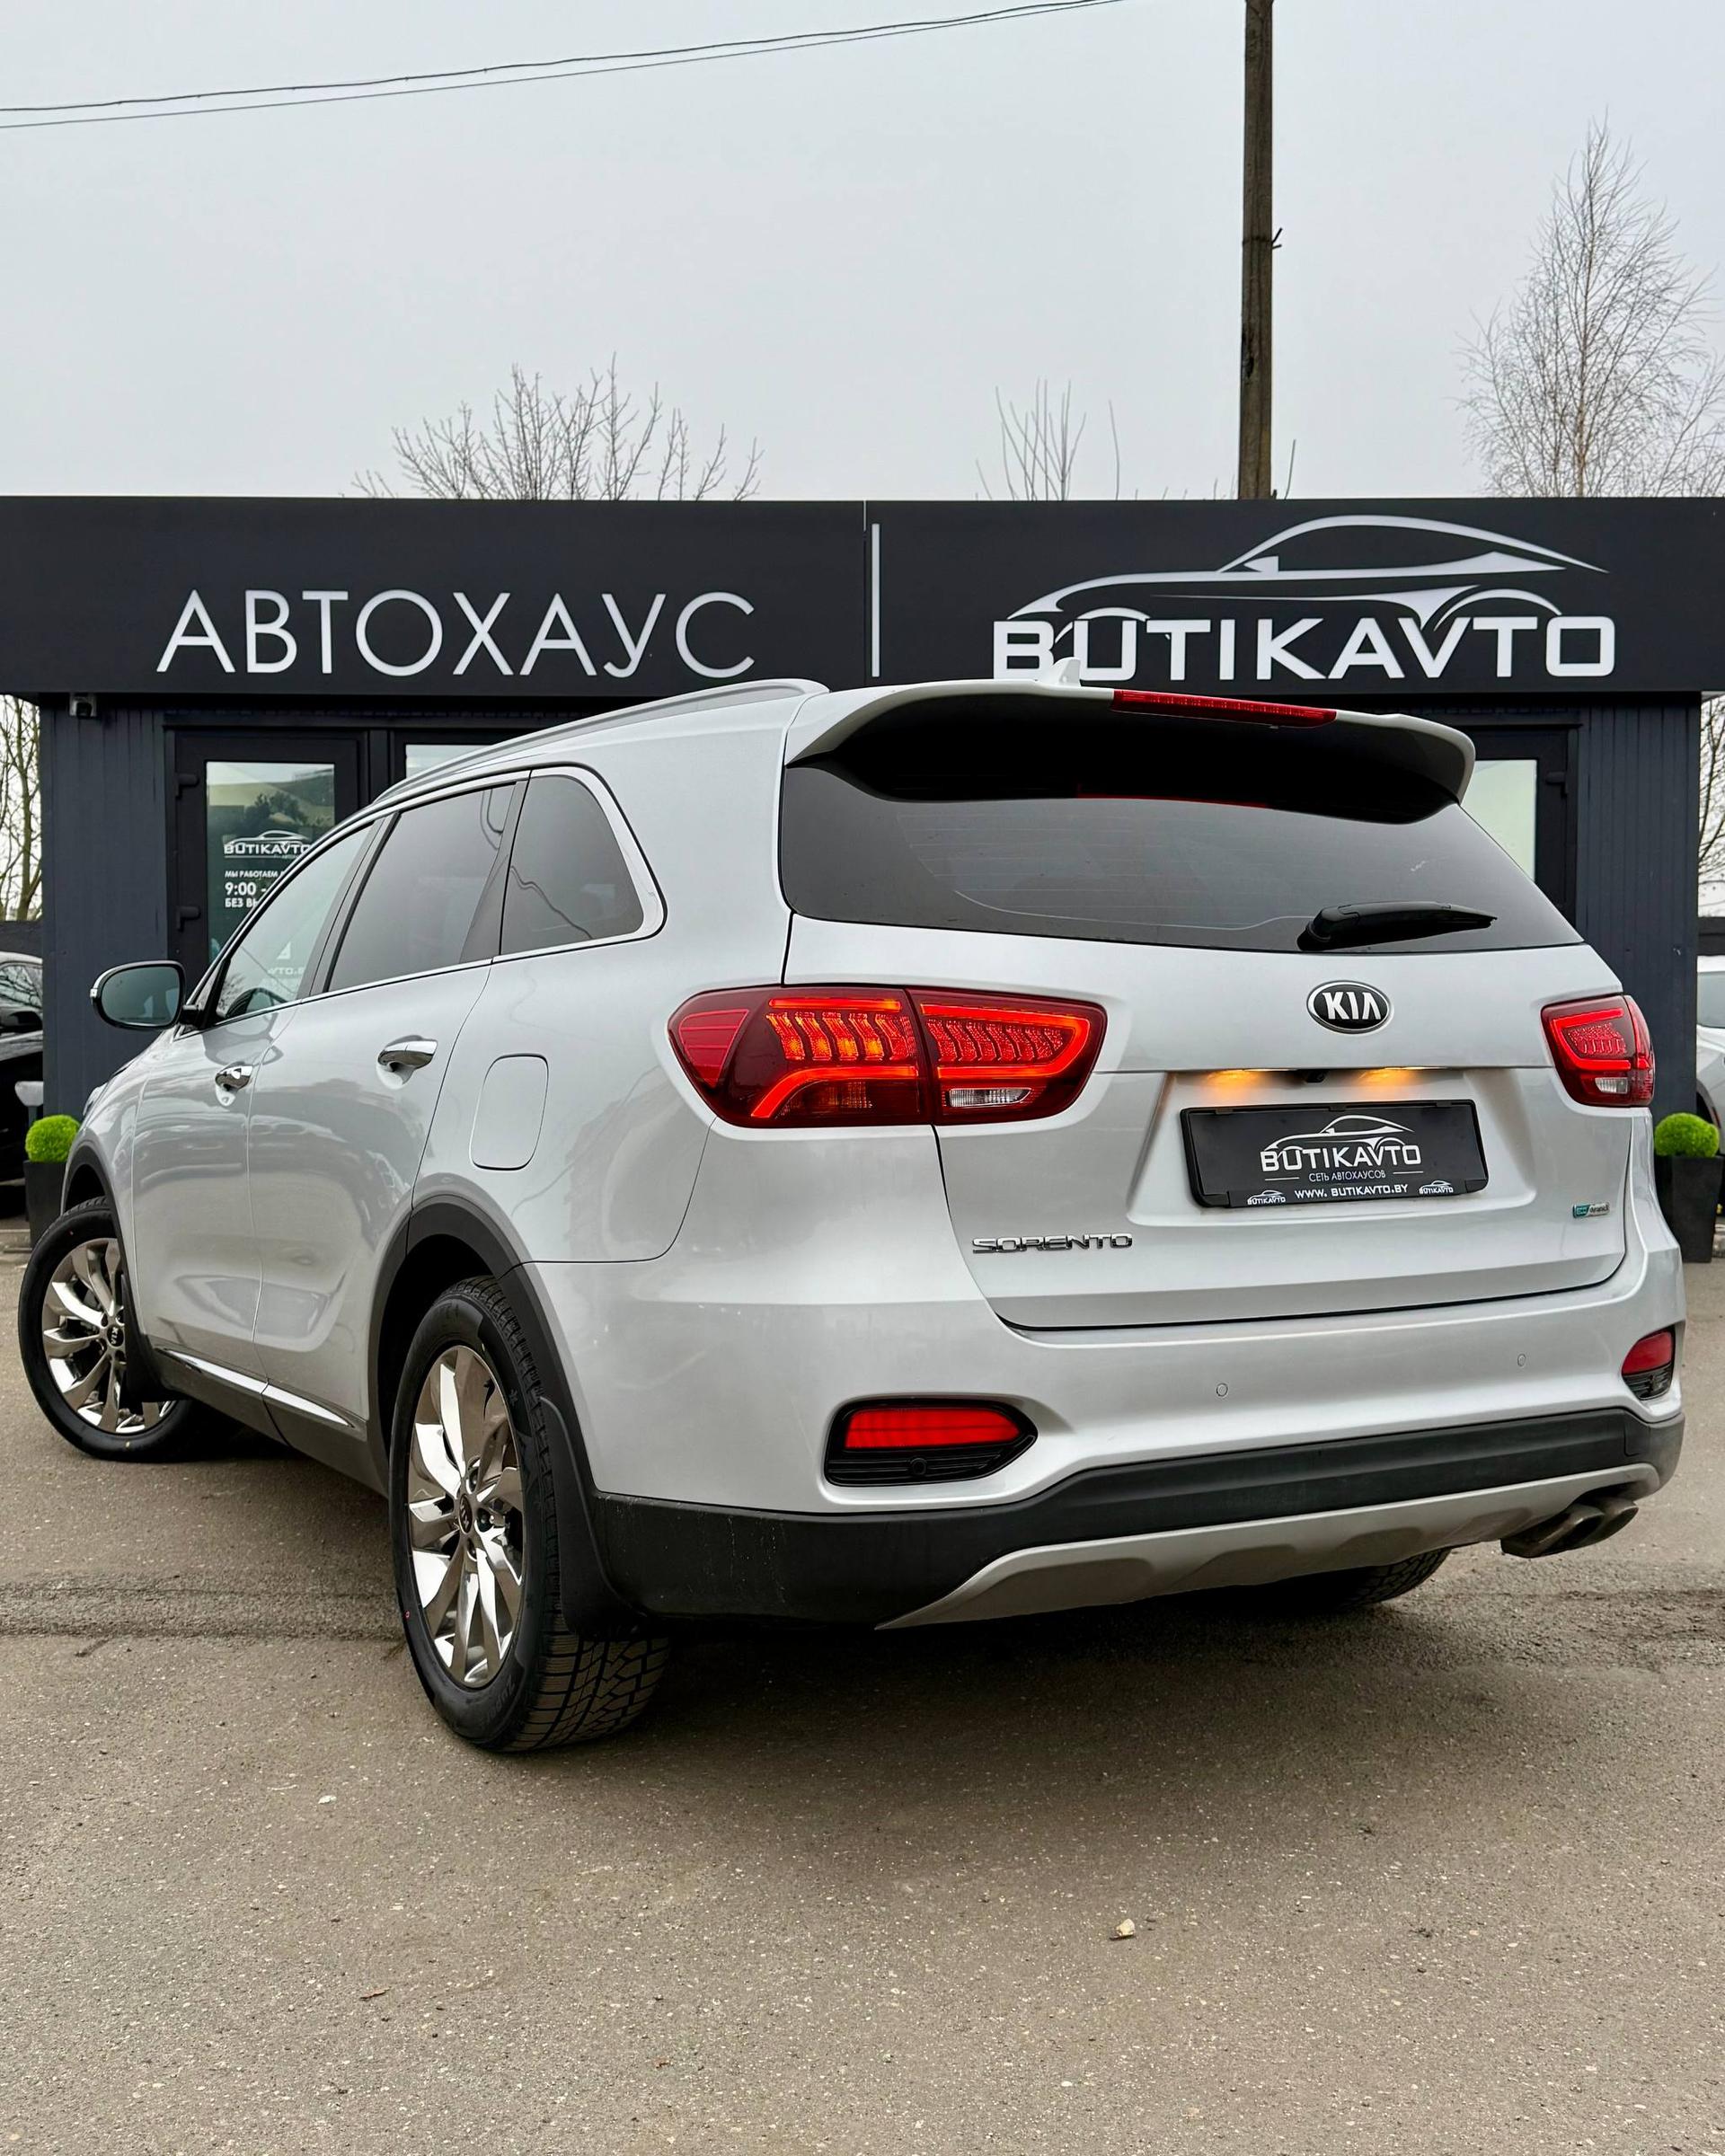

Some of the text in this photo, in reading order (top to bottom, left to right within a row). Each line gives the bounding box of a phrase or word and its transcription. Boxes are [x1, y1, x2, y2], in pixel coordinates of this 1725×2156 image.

[156, 588, 755, 677] АВТОХАУС
[993, 615, 1615, 680] BUTIKAVTO
[225, 881, 257, 896] 9:00
[225, 897, 243, 907] БЕЗ
[1322, 992, 1382, 1020] KIA
[1260, 1144, 1422, 1171] BUTIKAVTO
[1308, 1170, 1386, 1182] СЕТЬ АВТОХАУСОВ
[1331, 1184, 1409, 1197] BUTIKAVTO.BY
[972, 1233, 1133, 1254] SORENTO
